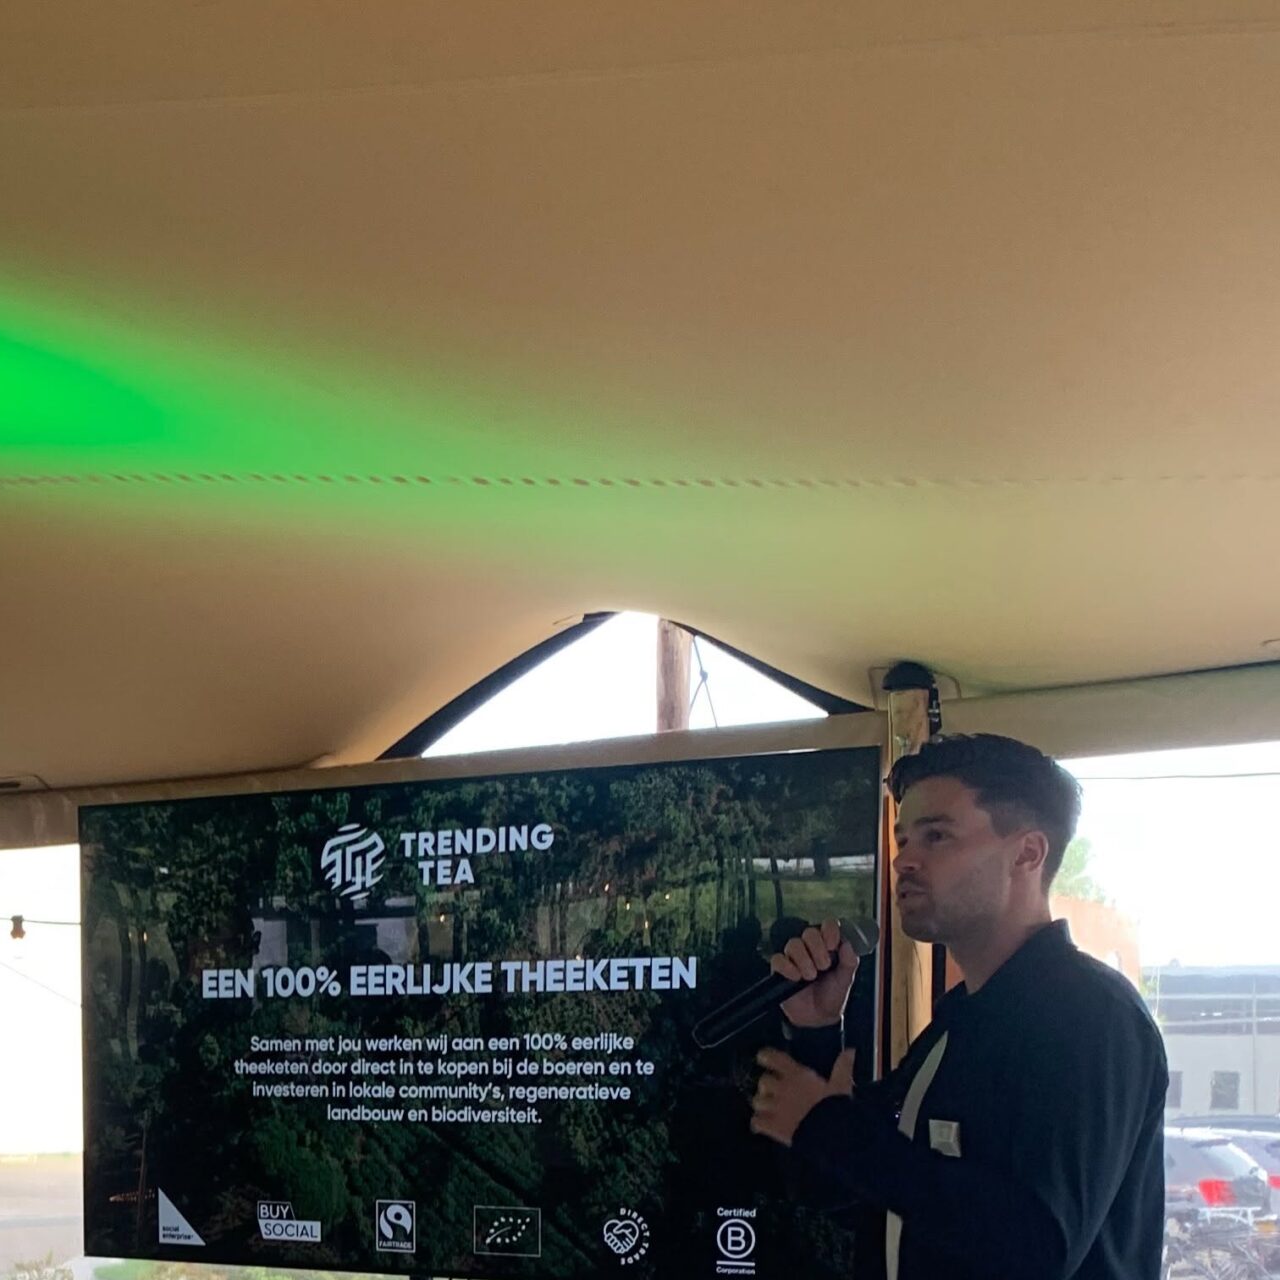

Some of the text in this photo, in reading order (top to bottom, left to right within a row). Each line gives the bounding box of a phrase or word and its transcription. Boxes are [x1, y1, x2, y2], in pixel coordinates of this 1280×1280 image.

[400, 823, 554, 857] TRENDING
[418, 858, 474, 886] TEA
[202, 956, 697, 999] EEN 100% EERLIJKE THEEKETEN
[250, 1033, 634, 1055] Samen met jou werken wij aan een 100% eerlijke
[234, 1058, 655, 1079] theeketen door direct in te kopen bij de boeren en te
[252, 1081, 329, 1097] investeren
[332, 1081, 346, 1097] in
[349, 1081, 395, 1098] lokale
[509, 1083, 631, 1103] regeneratieve
[327, 1104, 542, 1124] landbouw en biodiversiteit.
[260, 1203, 290, 1219] BUY
[716, 1207, 757, 1218] Certified
[264, 1222, 318, 1239] SOCIAL
[620, 1207, 651, 1266] DIRECT TRADE
[727, 1226, 746, 1251] B
[716, 1265, 756, 1275] Corporation
